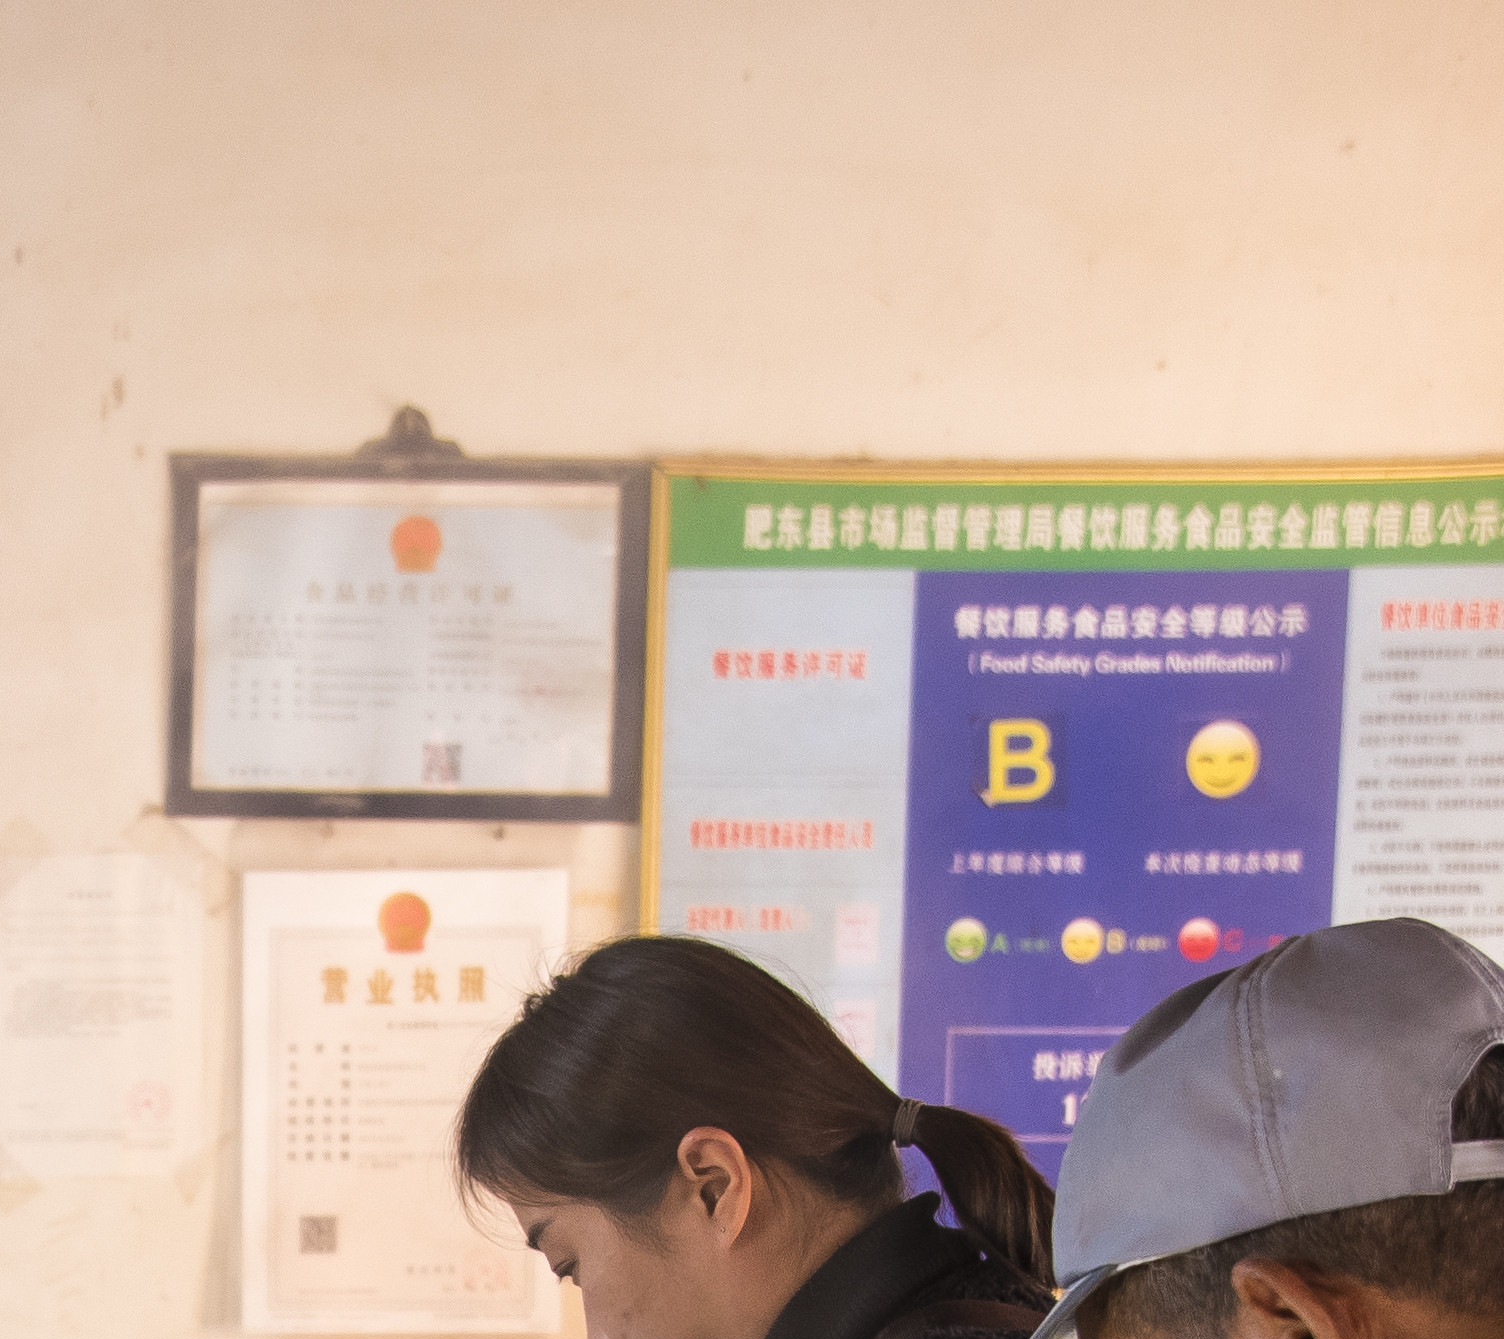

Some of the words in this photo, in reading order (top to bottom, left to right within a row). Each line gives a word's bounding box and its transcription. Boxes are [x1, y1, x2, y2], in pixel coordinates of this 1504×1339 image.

[954, 604, 1310, 639] 餐饮服务食品安全等级公示
[1031, 652, 1091, 677] Safety
[1095, 651, 1161, 674] Grades
[989, 717, 1055, 804] B
[321, 965, 486, 1006] 营业执照
